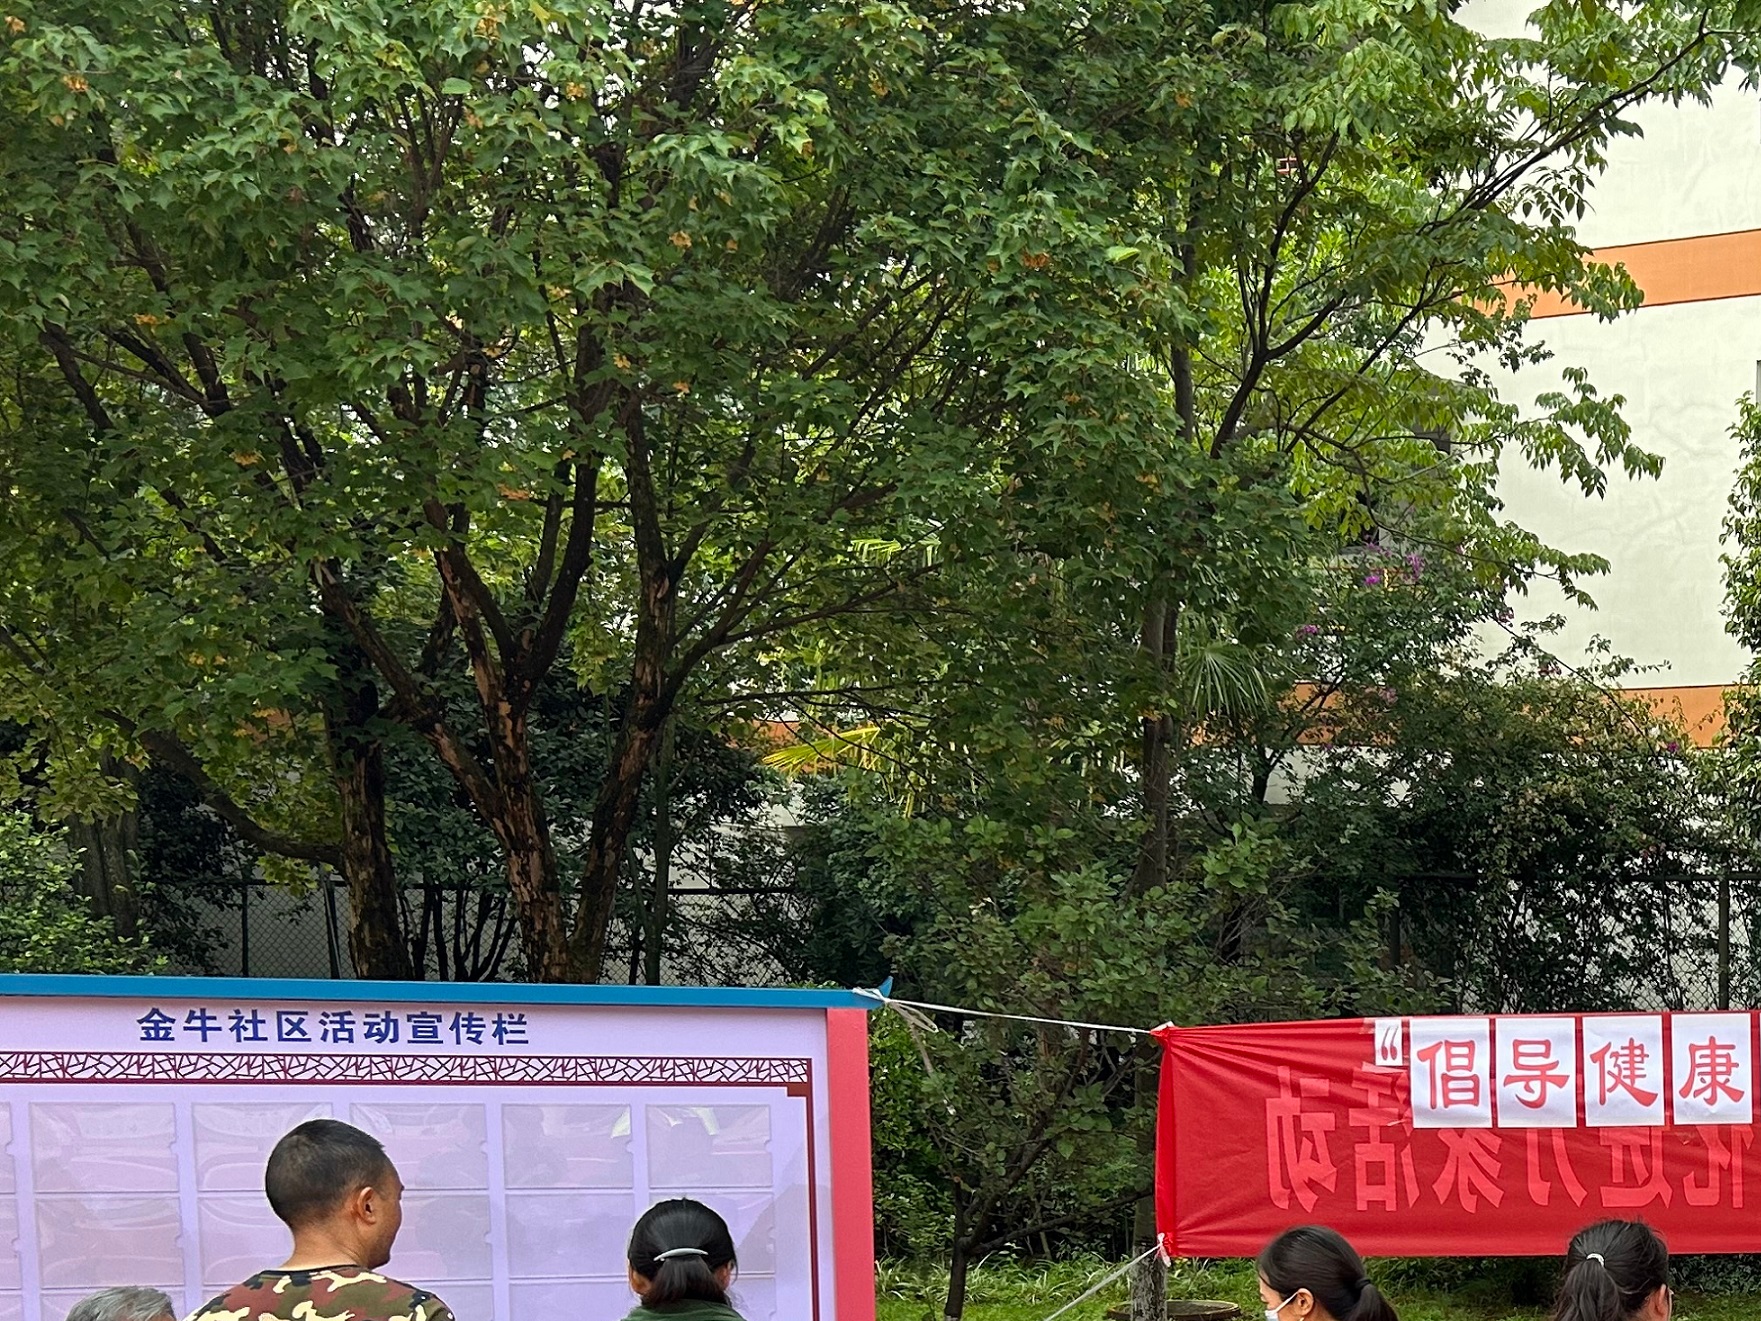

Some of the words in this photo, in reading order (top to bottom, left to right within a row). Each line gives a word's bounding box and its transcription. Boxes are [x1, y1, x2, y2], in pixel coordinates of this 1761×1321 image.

[135, 1006, 530, 1046] 金牛社区活动宣传栏
